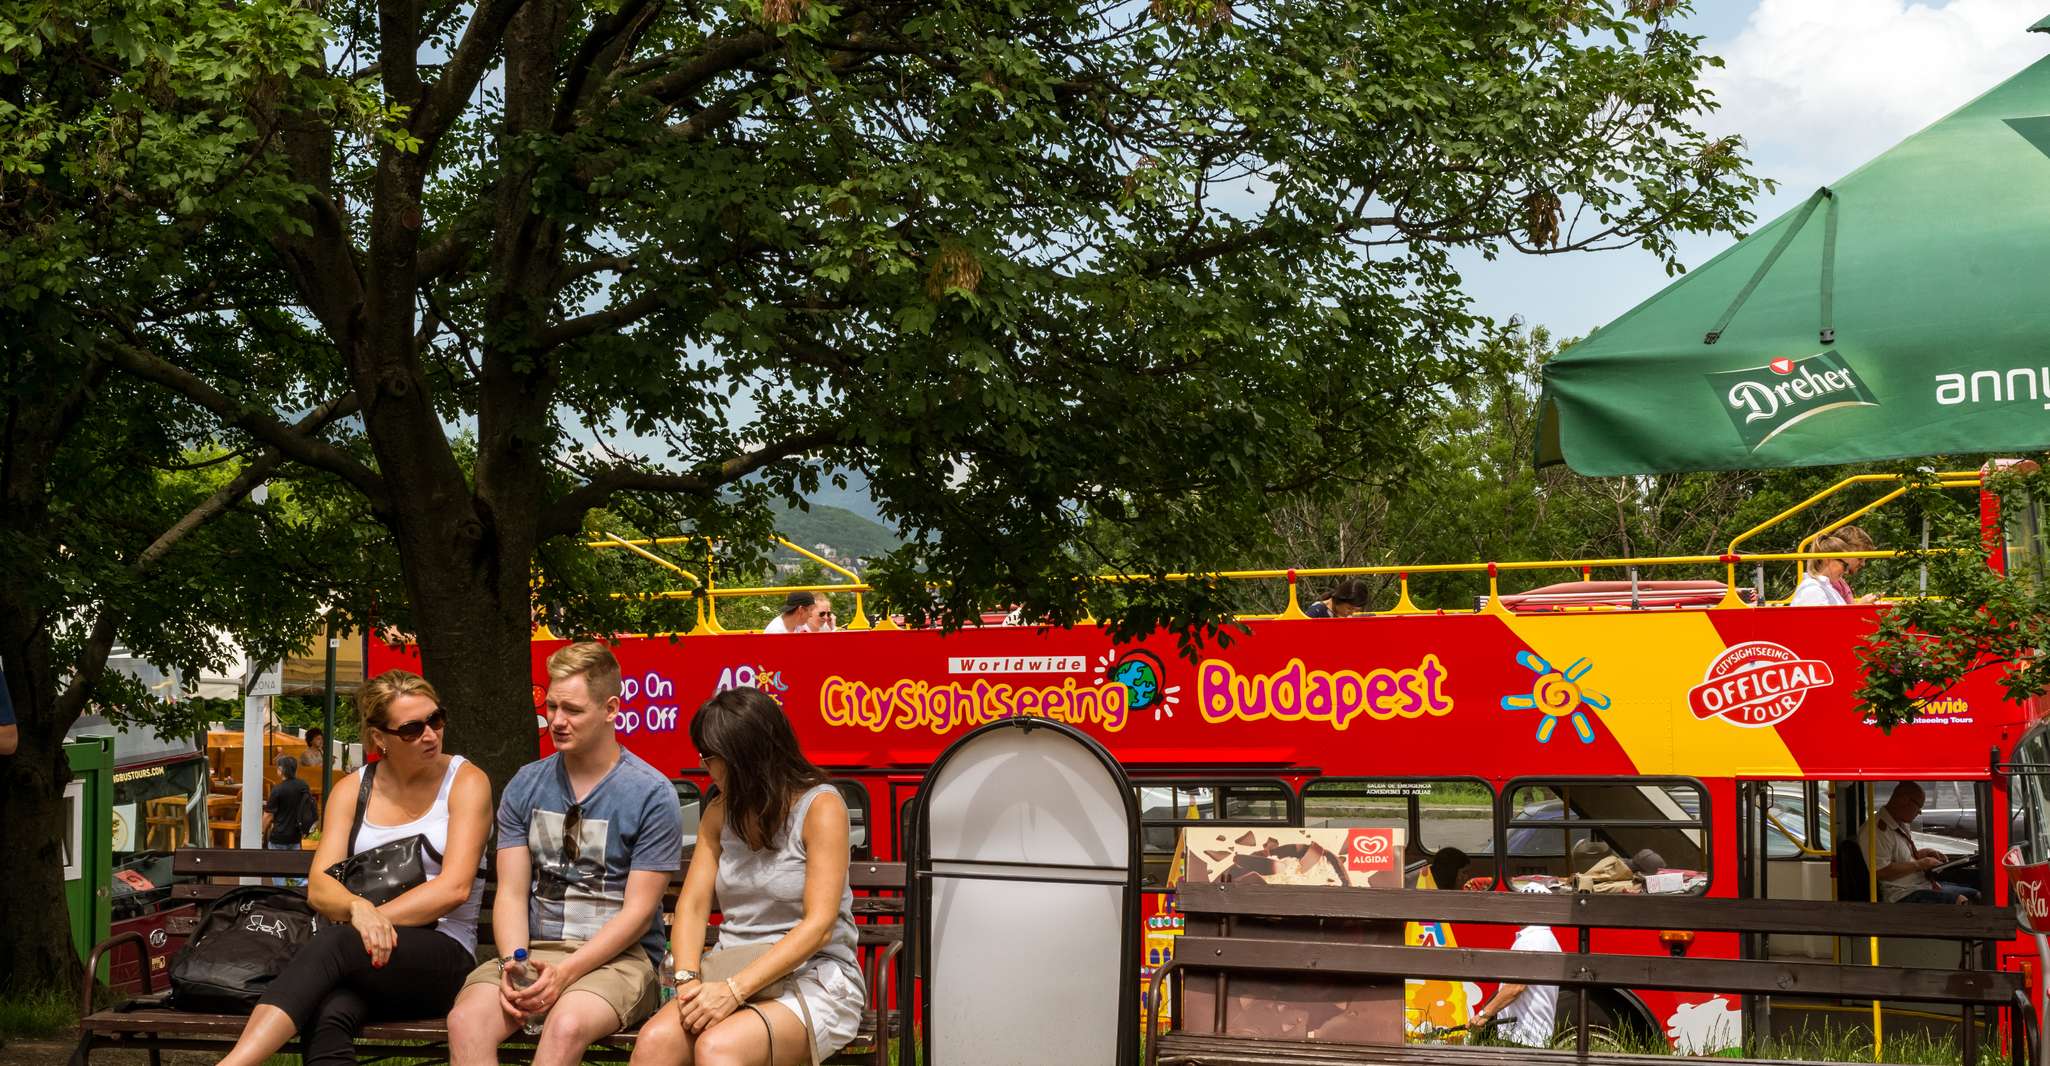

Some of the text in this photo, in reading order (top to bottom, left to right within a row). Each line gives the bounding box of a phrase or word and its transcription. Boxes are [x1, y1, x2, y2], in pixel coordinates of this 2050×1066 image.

[1728, 365, 1857, 425] Dreher
[959, 657, 1082, 672] Worldwide
[1715, 647, 1789, 676] CITYSIGHTSEEING
[645, 672, 673, 698] On
[1198, 653, 1454, 731] Budapest
[1702, 664, 1825, 711] OFFICIAL
[820, 675, 1129, 735] CitySightseeing
[1742, 696, 1797, 721] TOUR
[614, 705, 679, 734] op Off
[1950, 716, 1973, 724] Tours
[112, 766, 165, 784] IGBUSTOURS.COM
[1353, 855, 1388, 864] ALGIDA
